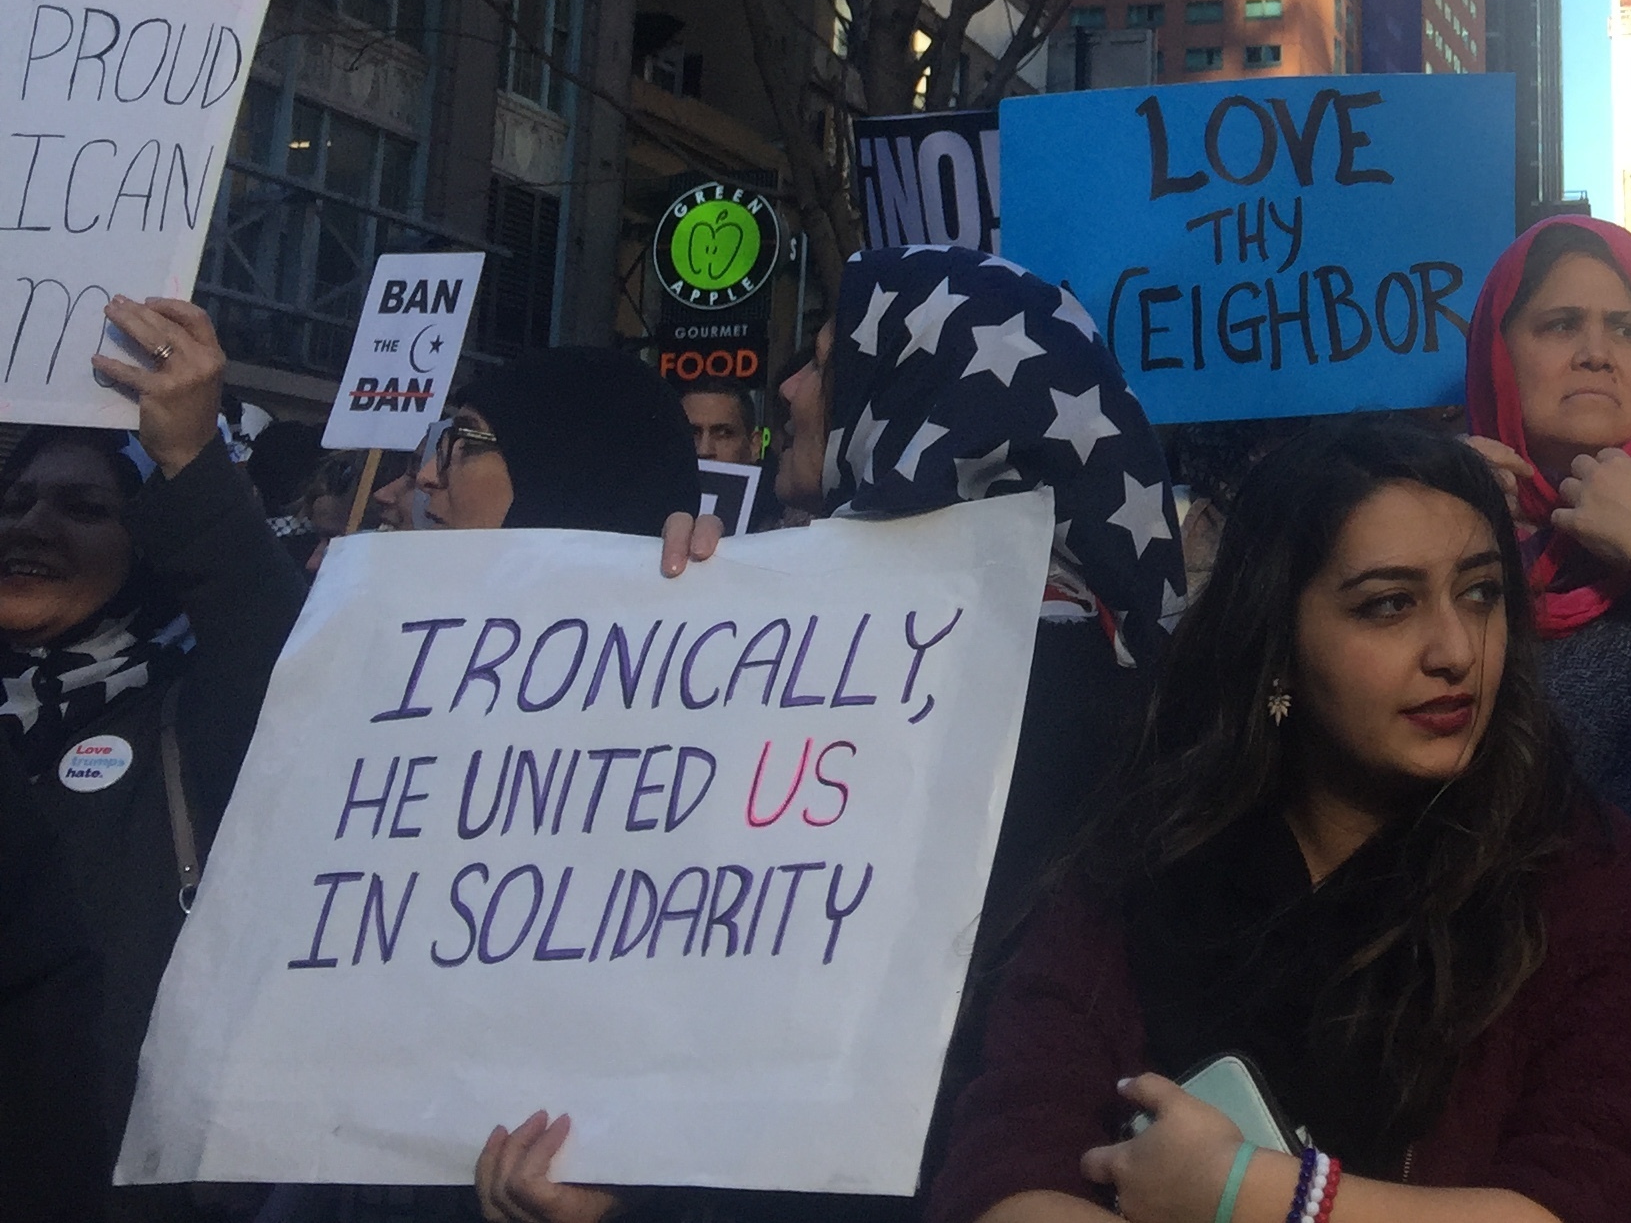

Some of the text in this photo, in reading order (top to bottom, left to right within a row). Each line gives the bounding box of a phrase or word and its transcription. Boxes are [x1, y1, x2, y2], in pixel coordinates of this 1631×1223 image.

[21, 4, 242, 109] PROUD
[1136, 87, 1395, 201] LOVE
[0, 133, 214, 234] ICAN
[674, 185, 763, 218] GREEN
[1187, 196, 1304, 274] THY
[378, 279, 463, 314] BAN
[670, 276, 755, 305] APPLE
[373, 339, 400, 352] THE
[675, 324, 749, 339] GOURMET
[660, 349, 759, 381] FOOD
[349, 377, 434, 412] BAN
[371, 607, 963, 724] IRONICALLY,
[76, 745, 112, 755] Love
[334, 738, 857, 841] HE UNITED US
[287, 861, 874, 969] IN SOLIDARITY
